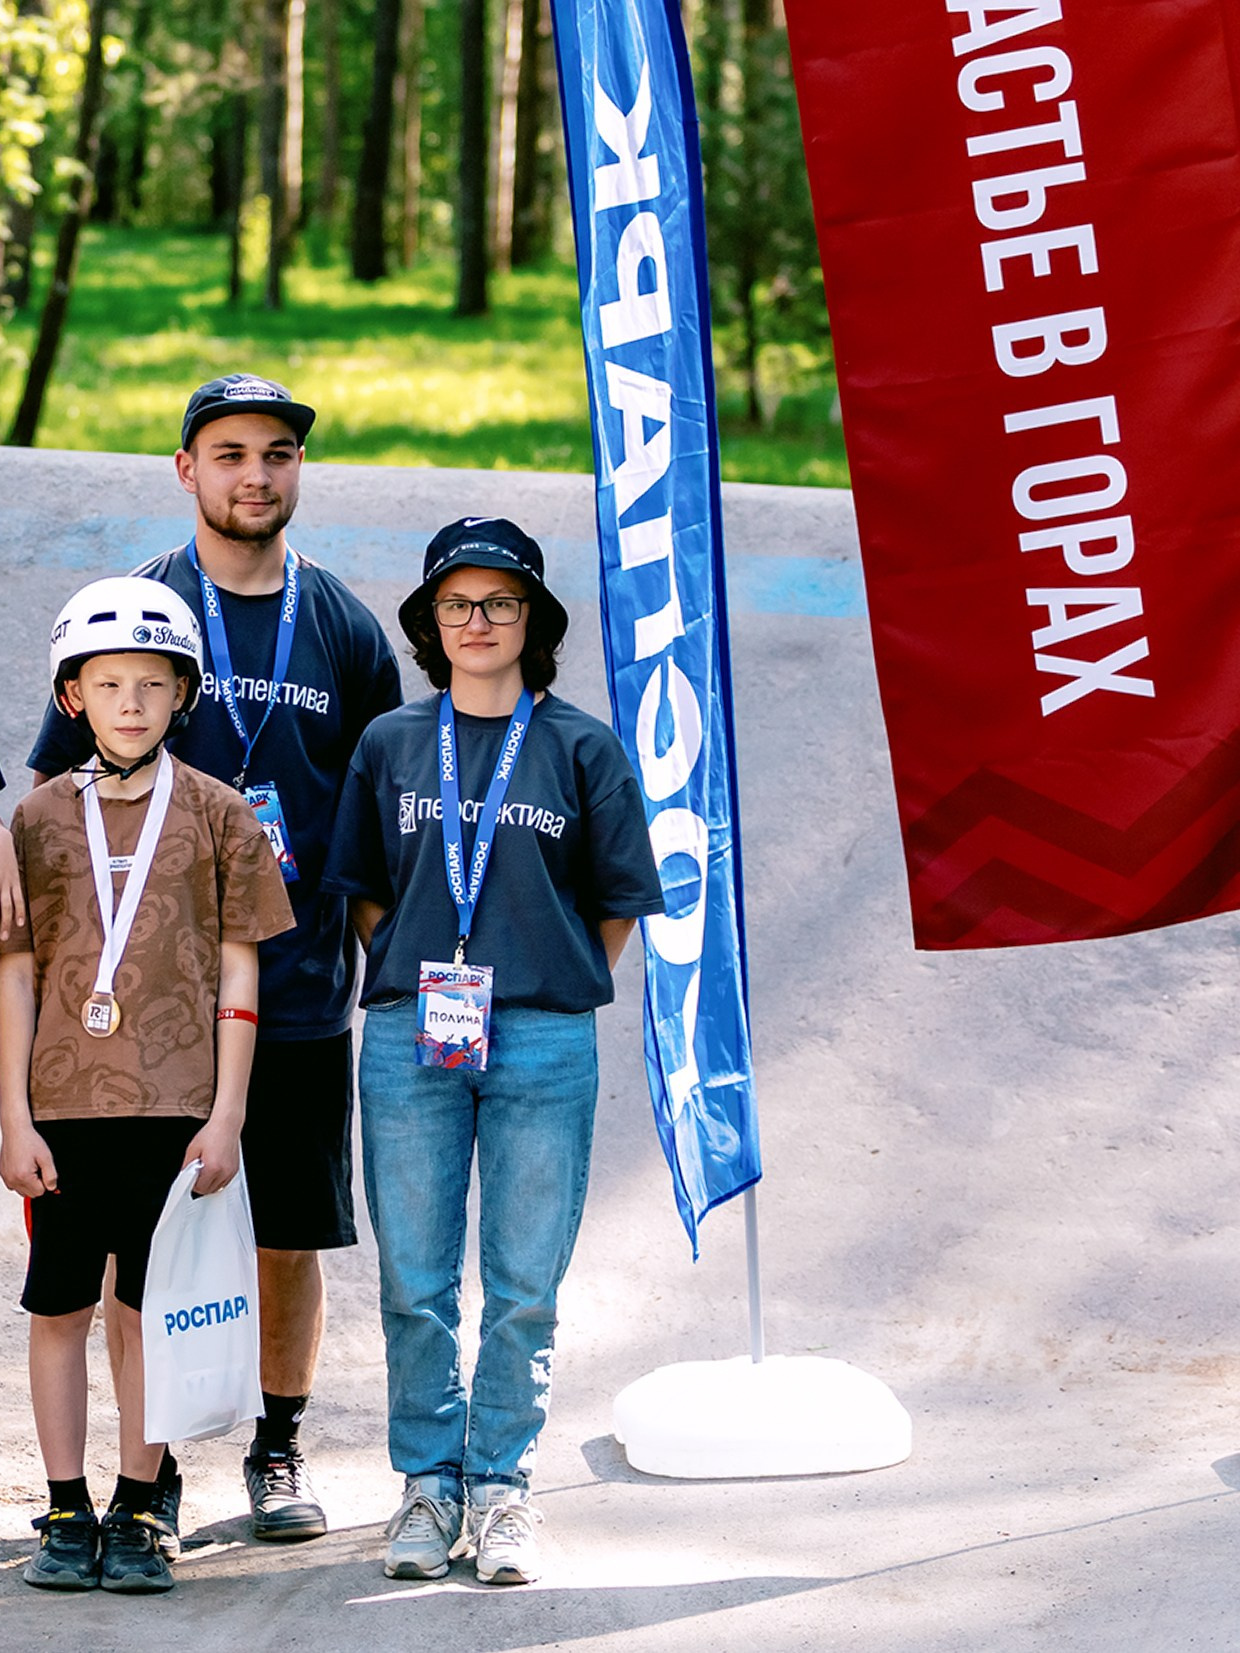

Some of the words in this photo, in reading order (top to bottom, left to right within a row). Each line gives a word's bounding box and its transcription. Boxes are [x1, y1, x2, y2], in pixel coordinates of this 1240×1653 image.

[945, 0, 1100, 293] АСТЬЕ
[991, 306, 1109, 378] В
[1003, 395, 1156, 717] ГОРАХ
[441, 723, 455, 782] РОСПАРК
[496, 721, 525, 781] РОСПАРК
[417, 798, 566, 840] песпктива
[447, 842, 466, 905] РОСПАРК
[466, 840, 489, 904] РОСПАРК
[427, 970, 486, 985] РОСПАРК
[428, 1010, 482, 1026] ПОЛИНА
